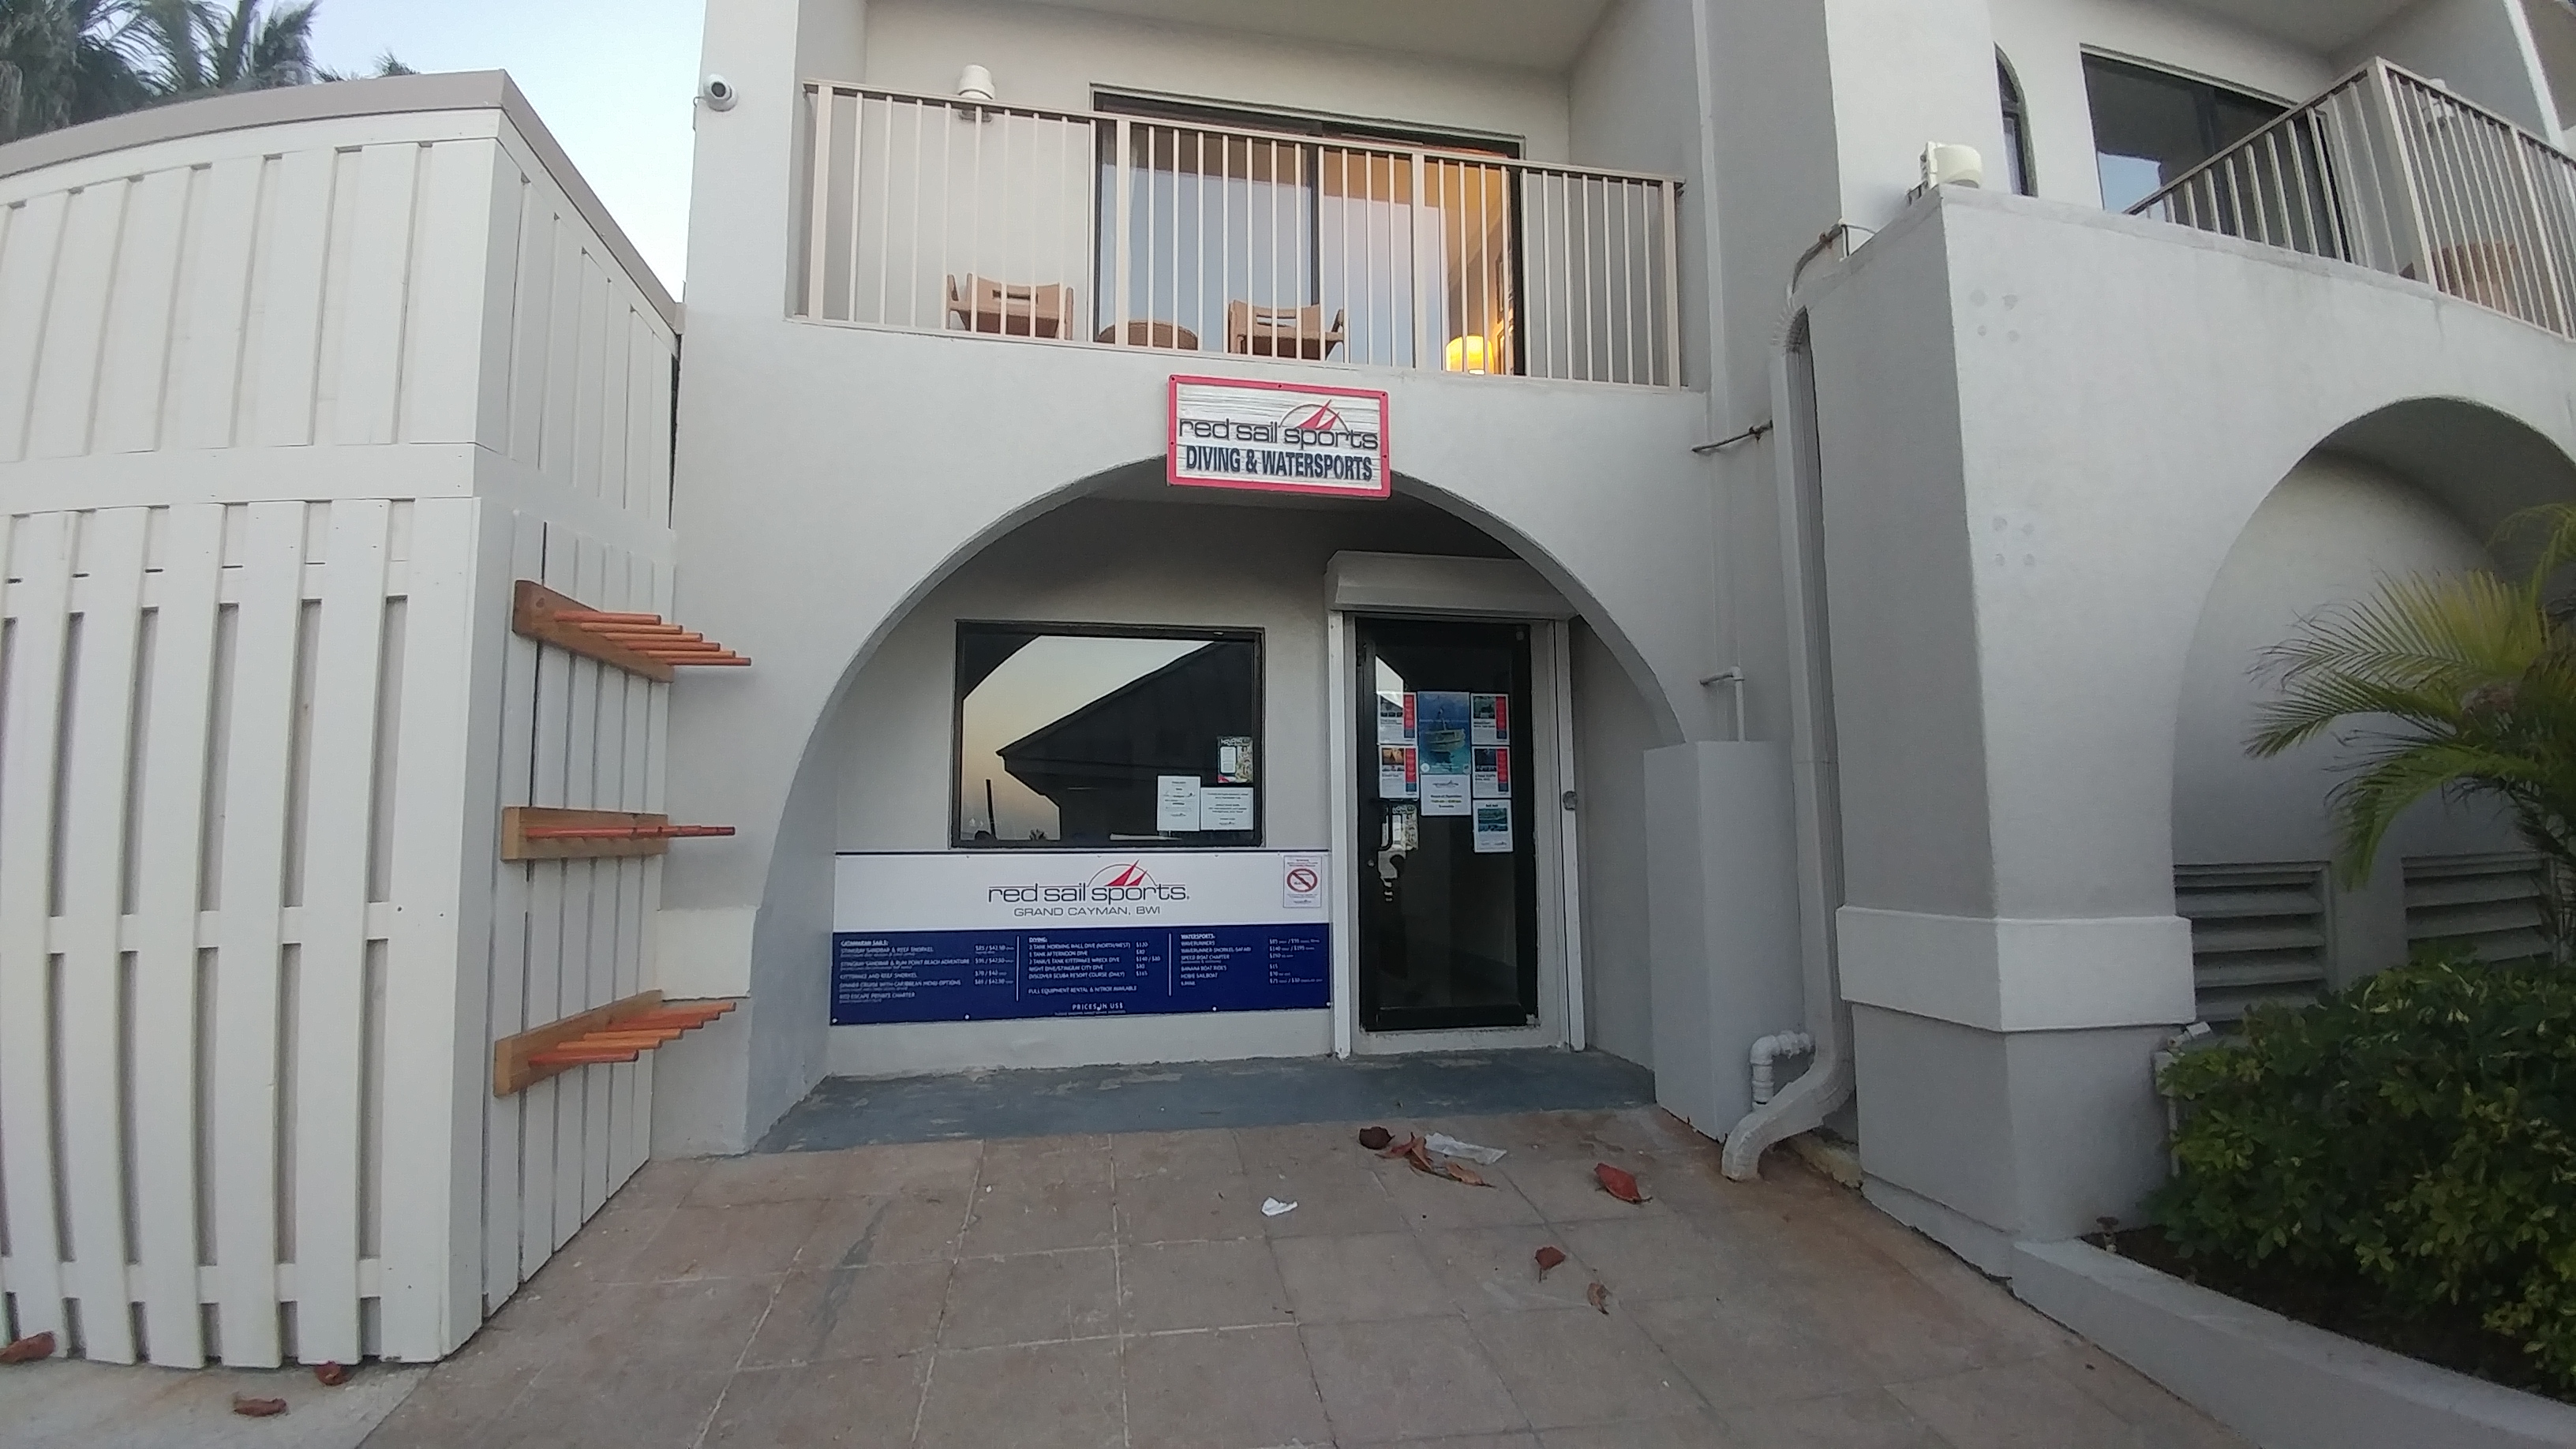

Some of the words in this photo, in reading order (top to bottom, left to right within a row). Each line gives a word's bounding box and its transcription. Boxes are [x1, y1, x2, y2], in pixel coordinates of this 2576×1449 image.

[1179, 419, 1230, 440] red
[1236, 421, 1278, 444] sail
[1284, 427, 1378, 450] sports
[1186, 445, 1241, 472] DIVING
[1245, 449, 1257, 474] &
[1262, 451, 1372, 481] WATERSPORTS
[989, 883, 1038, 903] red
[1043, 882, 1086, 902] sail
[1013, 908, 1064, 916] GRAND
[1068, 907, 1131, 916] CAYMAN,
[1136, 906, 1160, 915] BWI
